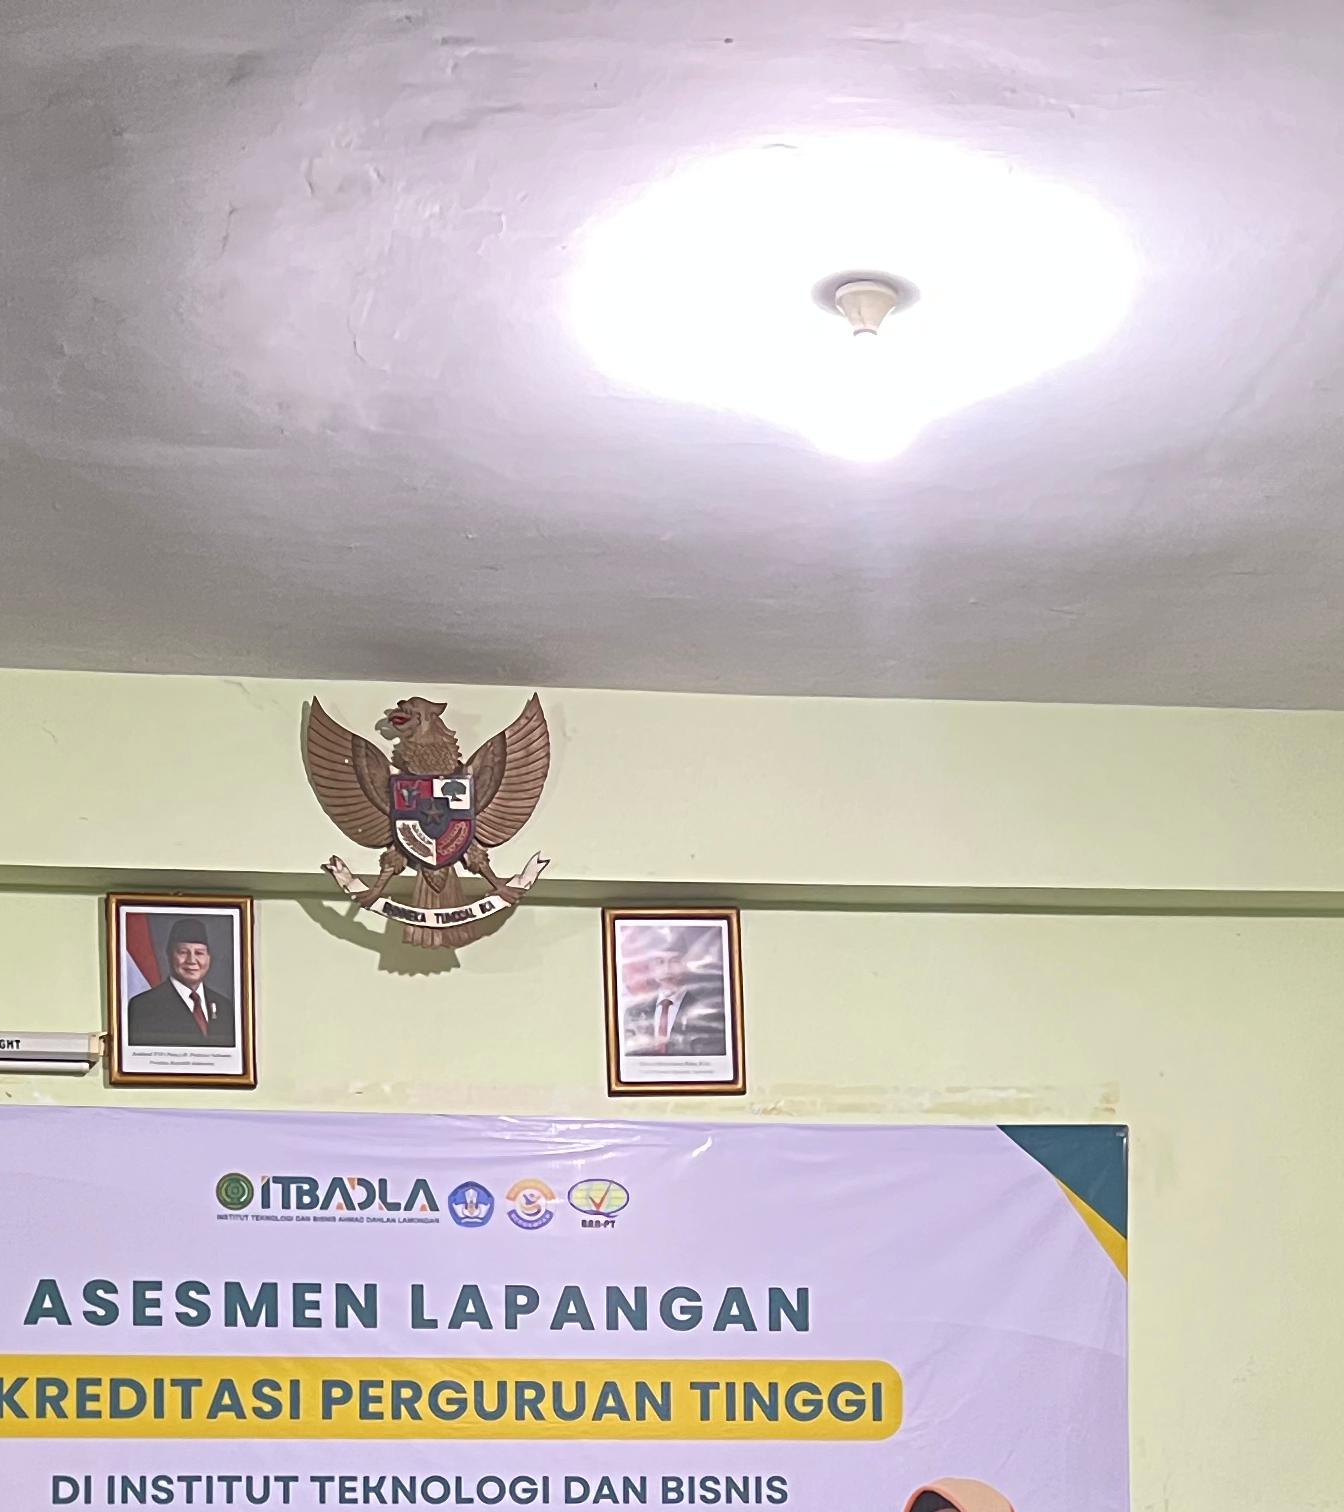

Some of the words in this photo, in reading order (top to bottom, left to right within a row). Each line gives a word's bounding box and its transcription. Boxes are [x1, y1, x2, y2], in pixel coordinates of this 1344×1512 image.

[23, 1278, 378, 1328] ASESMEN
[411, 1283, 810, 1332] LAPANGAN
[321, 1379, 672, 1422] PERGURUAN
[689, 1380, 883, 1422] TINGGI
[51, 1475, 92, 1505] DI
[107, 1475, 299, 1505] INSTITUT
[310, 1475, 550, 1505] TEKNOLOGI
[564, 1475, 648, 1504] DAN
[661, 1475, 789, 1505] BISNIS
